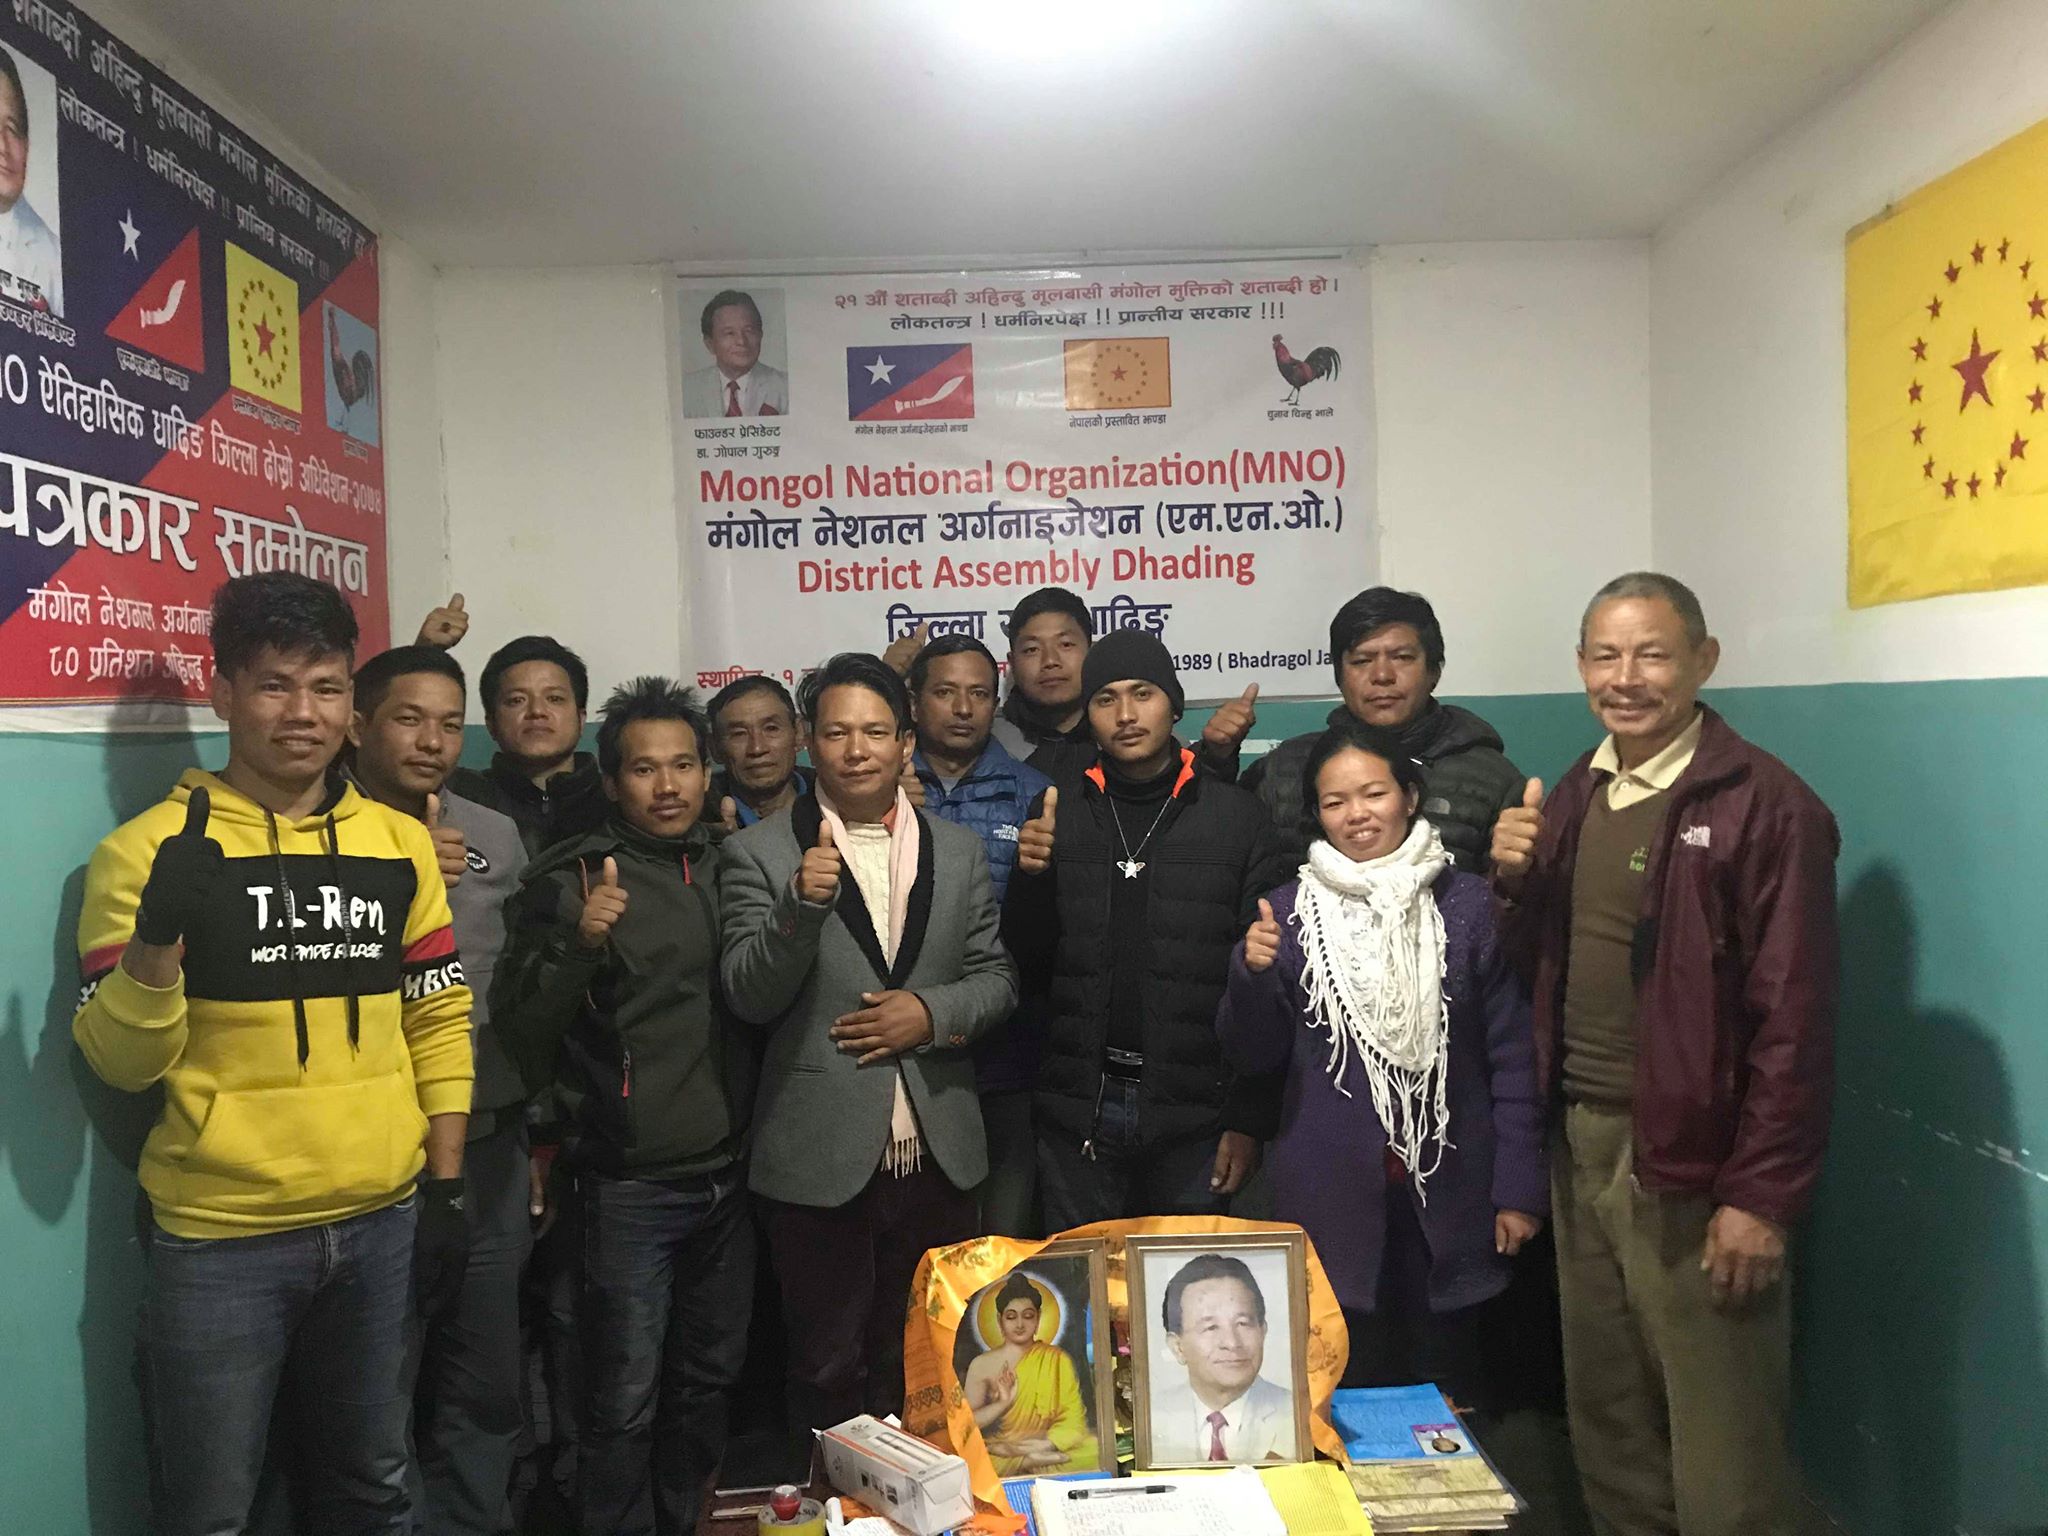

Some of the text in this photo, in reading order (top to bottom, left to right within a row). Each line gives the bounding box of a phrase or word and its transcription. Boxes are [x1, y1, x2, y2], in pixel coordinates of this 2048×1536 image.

[895, 288, 958, 306] शताब्दी
[965, 286, 1026, 307] अहिन्दु
[1110, 281, 1162, 299] मंगोल
[1168, 278, 1234, 301] मुक्तिको
[1240, 276, 1302, 295] शताब्दी
[890, 313, 972, 330] लोकतन्त्र
[994, 308, 1088, 327] धर्मनिरपेक्ष
[1118, 305, 1184, 325] प्रान्तीय
[1189, 305, 1253, 320] सरकार
[38, 355, 144, 439] ऐतिहासिक
[700, 446, 1345, 508] Mongol National Organization(MNO)
[706, 489, 1343, 549] मंगोल नेशनल अर्गनाइजेशन (एम.एन.ओ.)
[798, 545, 1256, 593] District Assembly Dhading
[27, 580, 90, 626] मंगोल
[98, 585, 155, 631] नेशनल
[87, 637, 154, 682] प्रतिशत
[1173, 653, 1212, 671] 1989
[1228, 649, 1312, 671] Bhadragol
